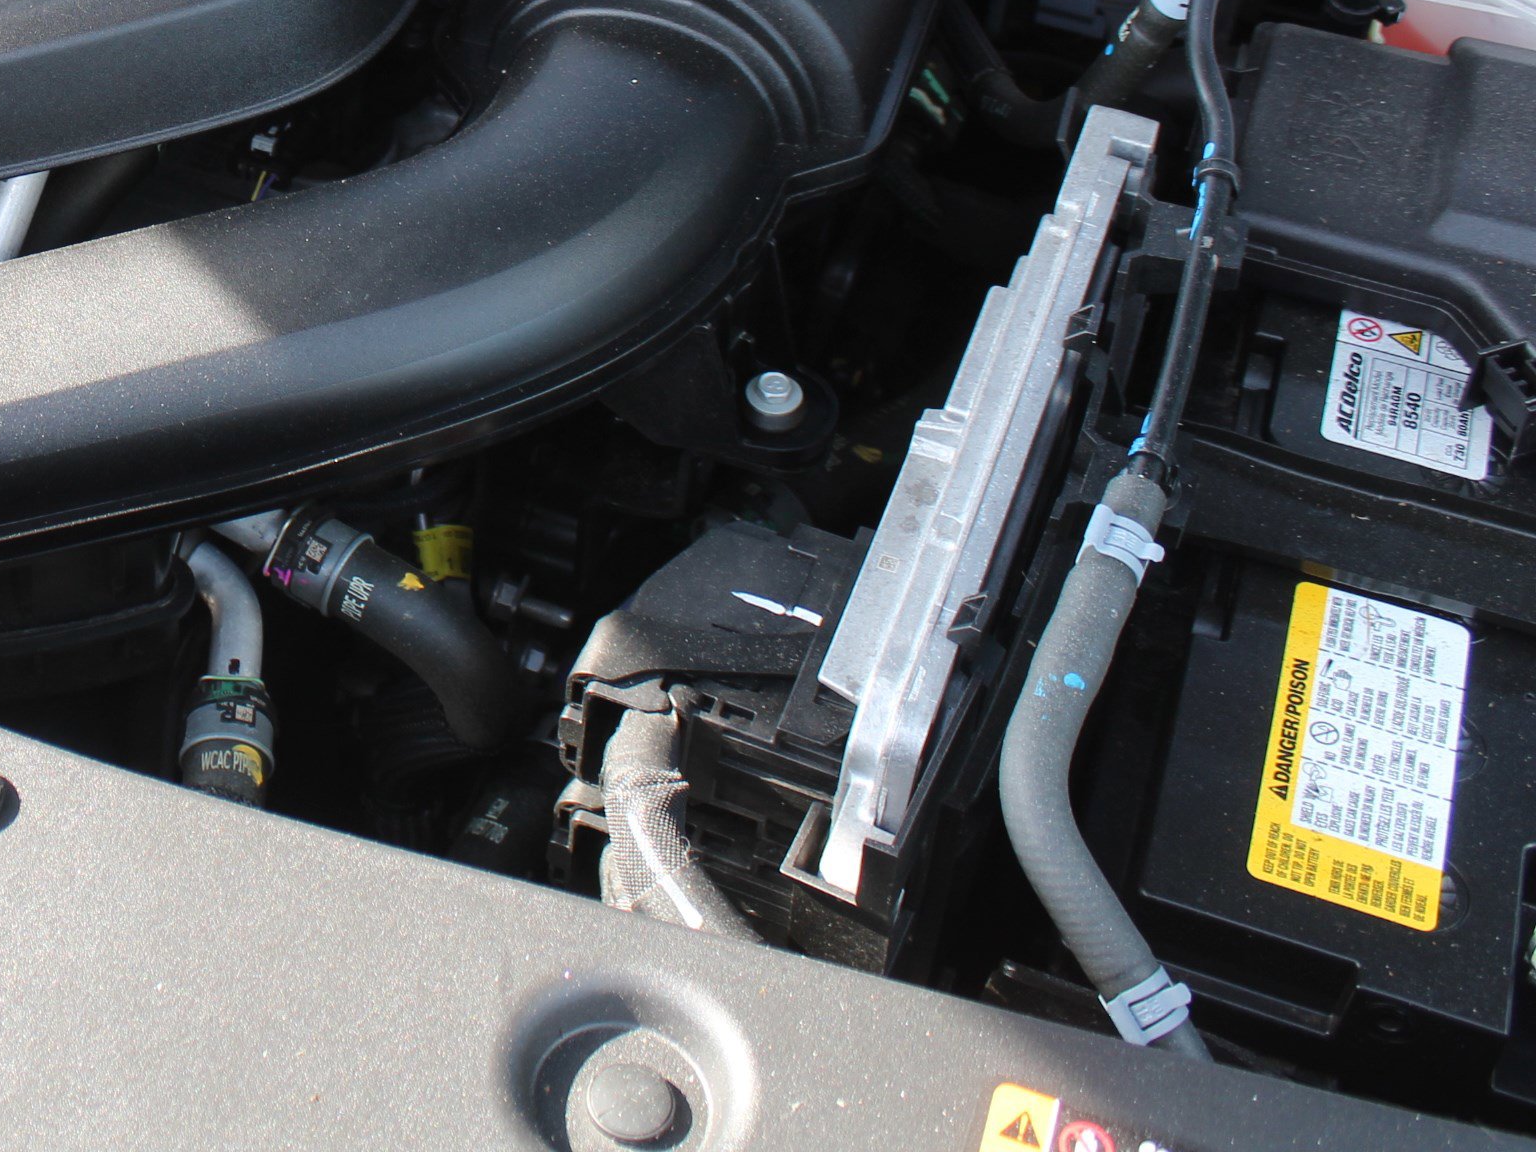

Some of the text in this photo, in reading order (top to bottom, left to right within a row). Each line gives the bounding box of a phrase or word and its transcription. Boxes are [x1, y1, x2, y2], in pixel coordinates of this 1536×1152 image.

[1337, 352, 1363, 434] ACDelco
[1402, 392, 1422, 430] 8540
[1454, 444, 1466, 462] 730
[341, 576, 375, 622] PIPE UPR
[1316, 682, 1331, 708] SULFURIC
[1331, 699, 1343, 712] ACID
[1274, 658, 1309, 784] DANGER/POISON
[201, 750, 231, 771] WCAC
[1380, 787, 1395, 804] YEUX
[1300, 802, 1314, 824] SHIELD
[1378, 803, 1392, 816] LES
[1315, 813, 1328, 828] EYES
[1263, 860, 1274, 874] KEEP
